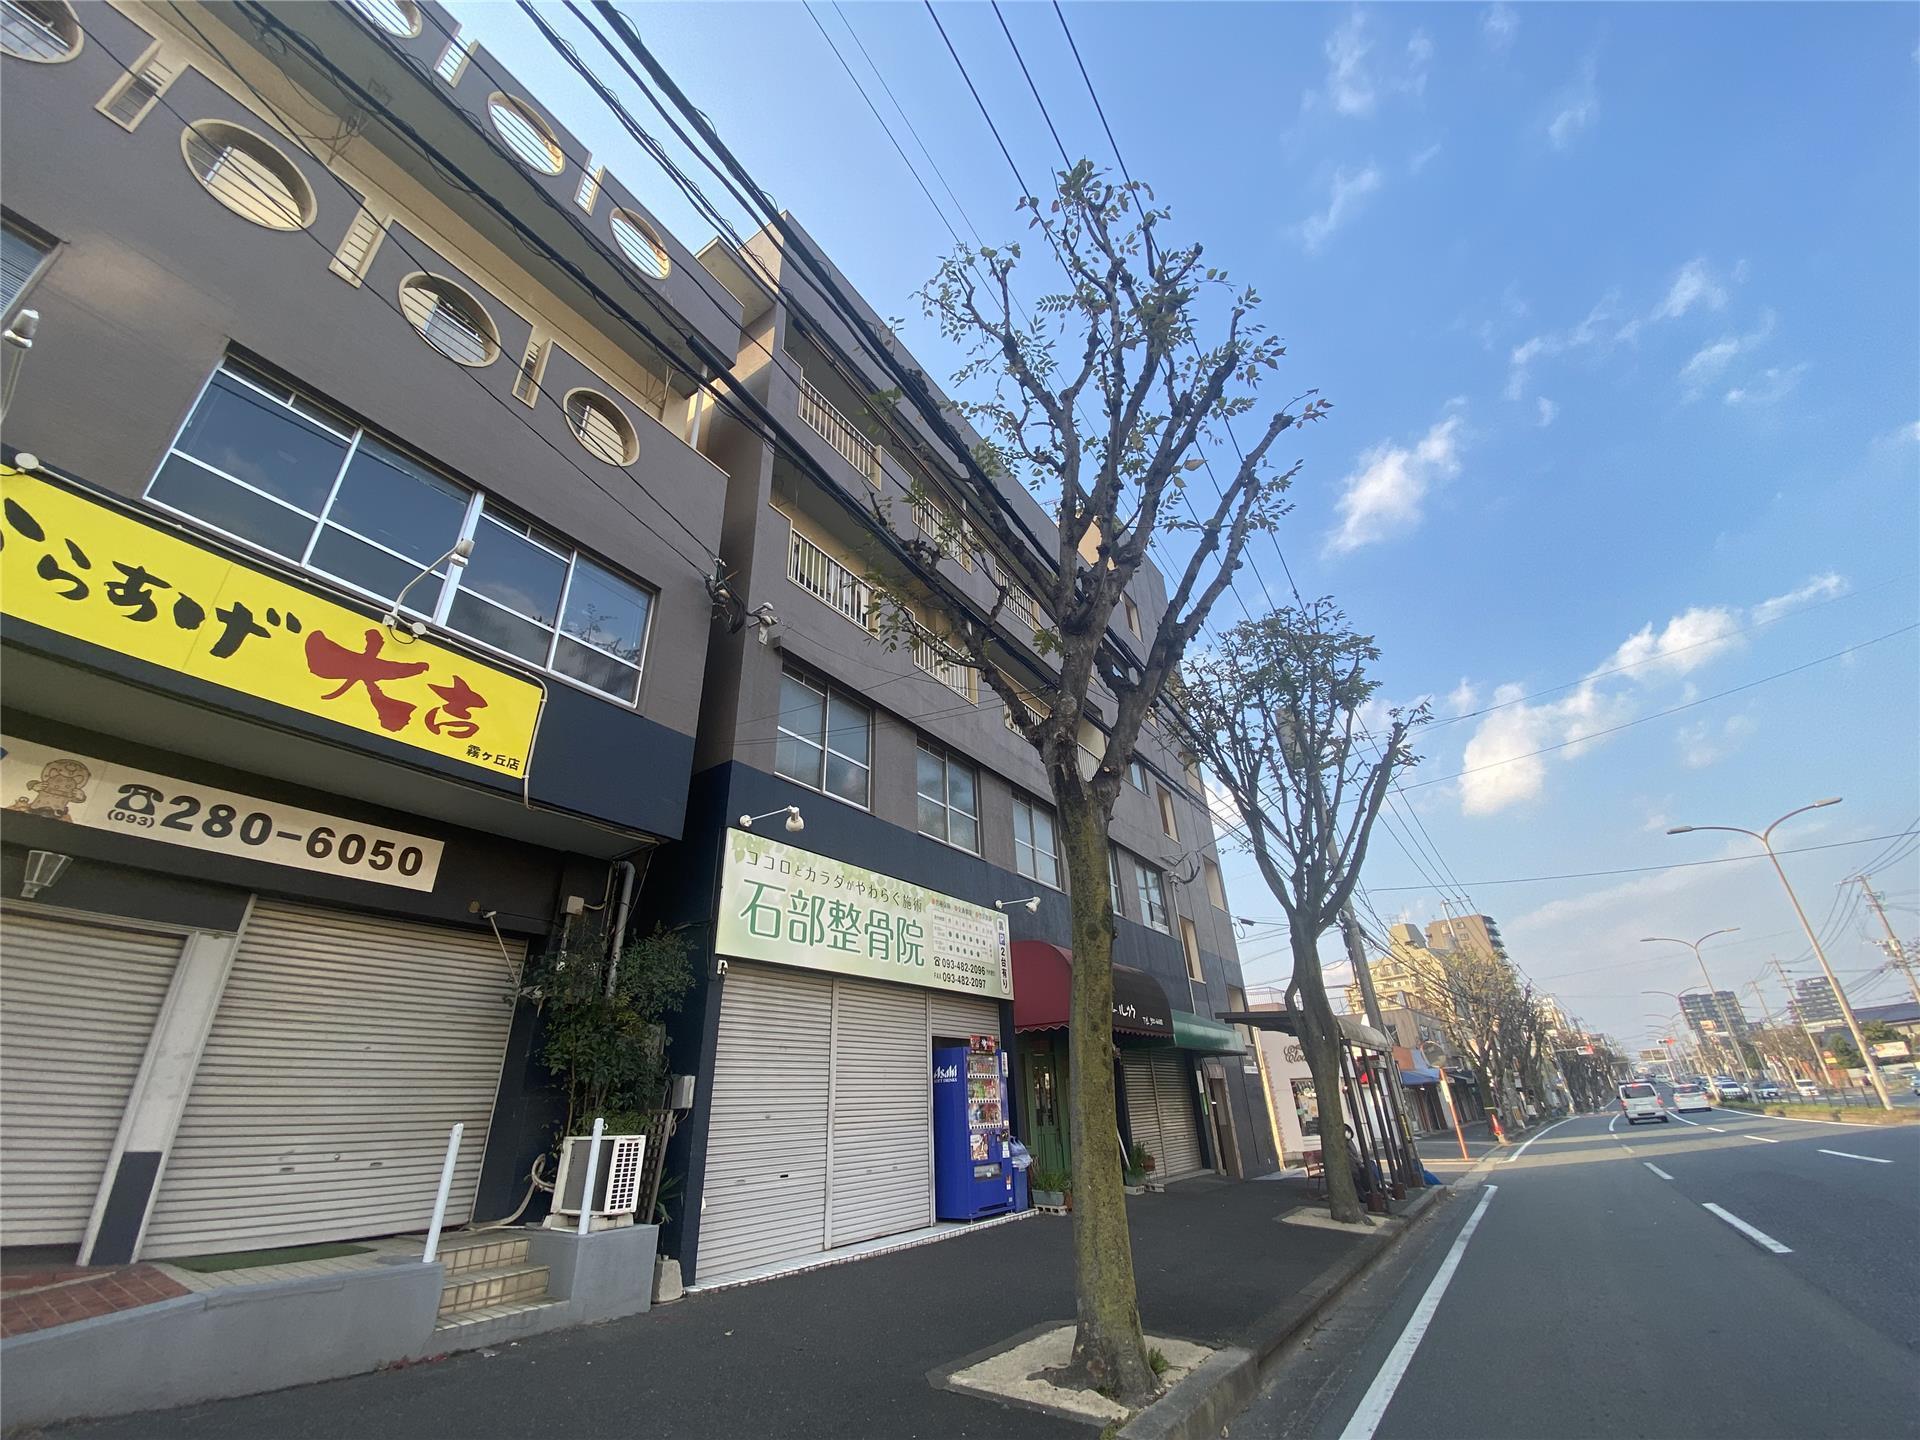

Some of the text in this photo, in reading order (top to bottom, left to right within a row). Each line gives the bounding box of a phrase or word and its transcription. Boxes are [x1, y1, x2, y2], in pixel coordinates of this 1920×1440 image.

[107, 795, 424, 878] (093) 280-6050
[745, 850, 923, 913] ココロとカラダがやわらぐ施術
[740, 878, 925, 967] 石部整骨院
[934, 1064, 958, 1079] Asahi
